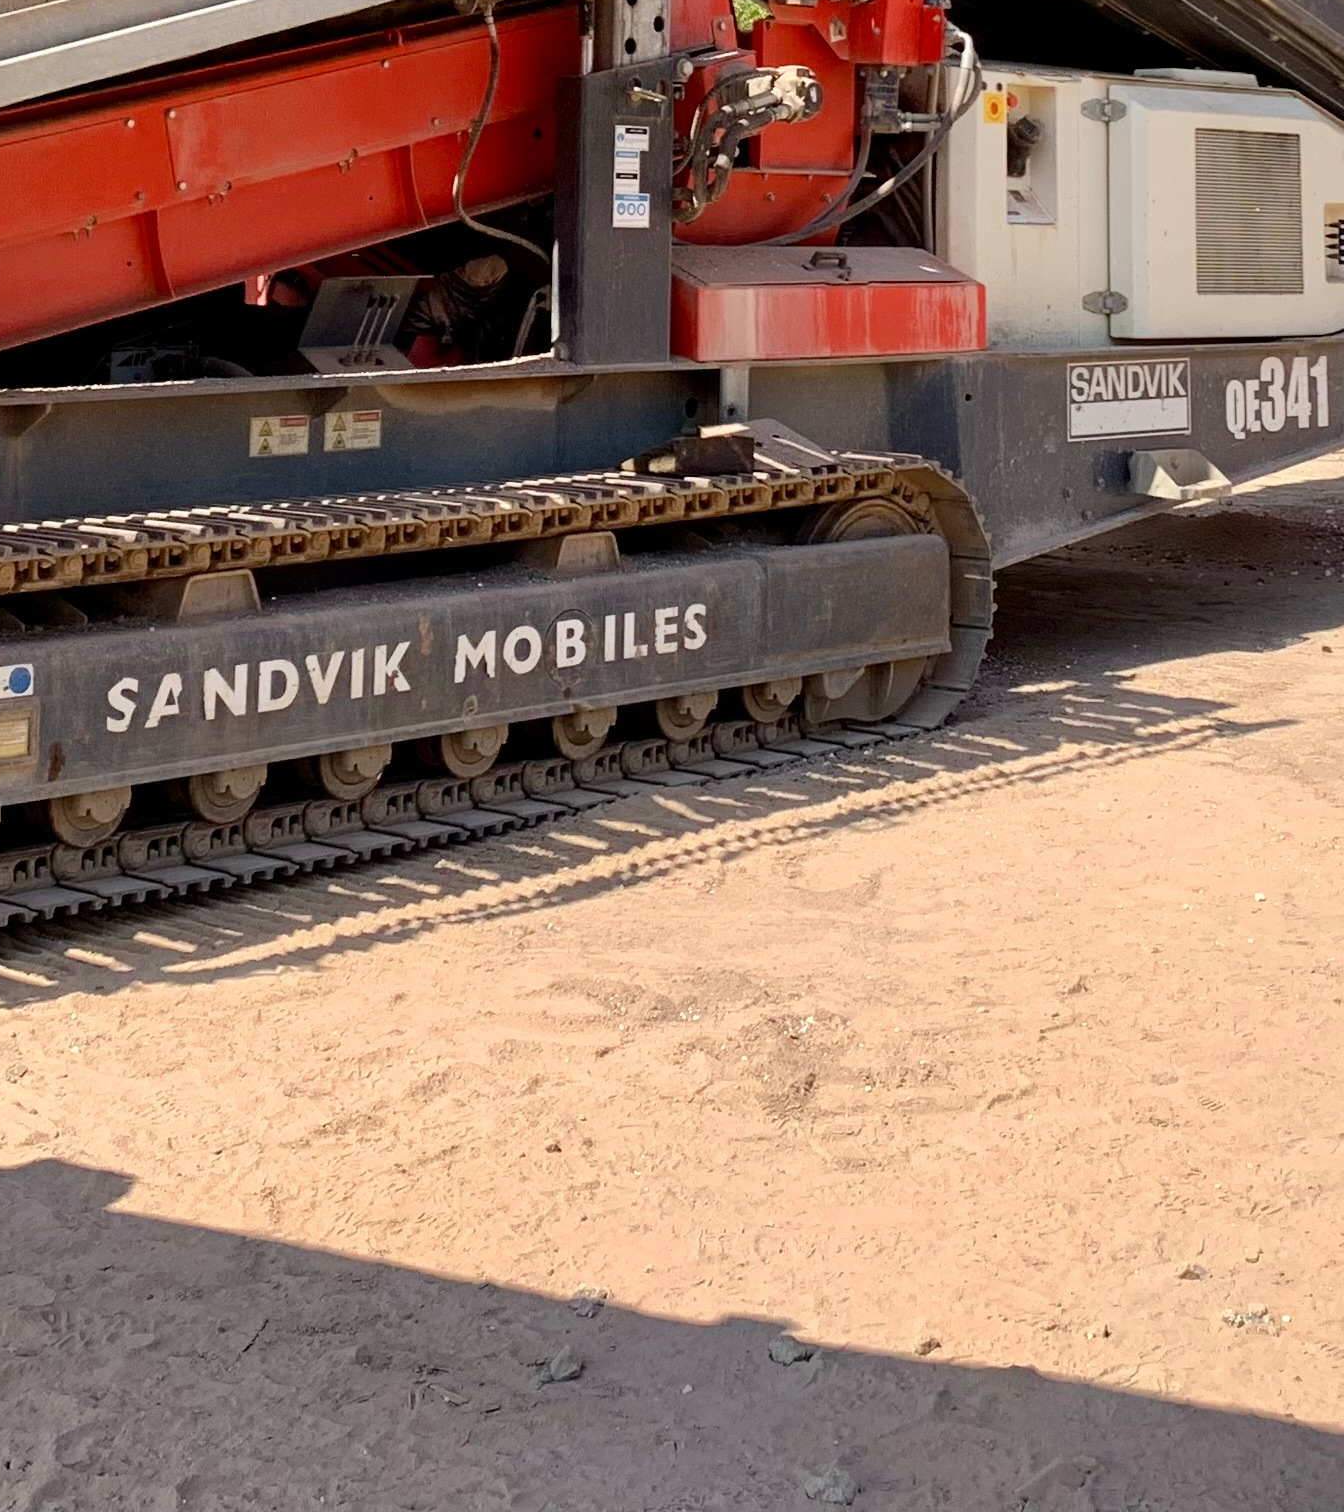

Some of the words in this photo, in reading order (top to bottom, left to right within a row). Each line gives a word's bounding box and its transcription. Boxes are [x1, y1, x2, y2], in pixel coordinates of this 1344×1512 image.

[1071, 362, 1186, 402] SANDVIK
[1225, 355, 1330, 439] QE341
[106, 641, 411, 732] SANDVIK
[455, 603, 708, 685] MOBILES
